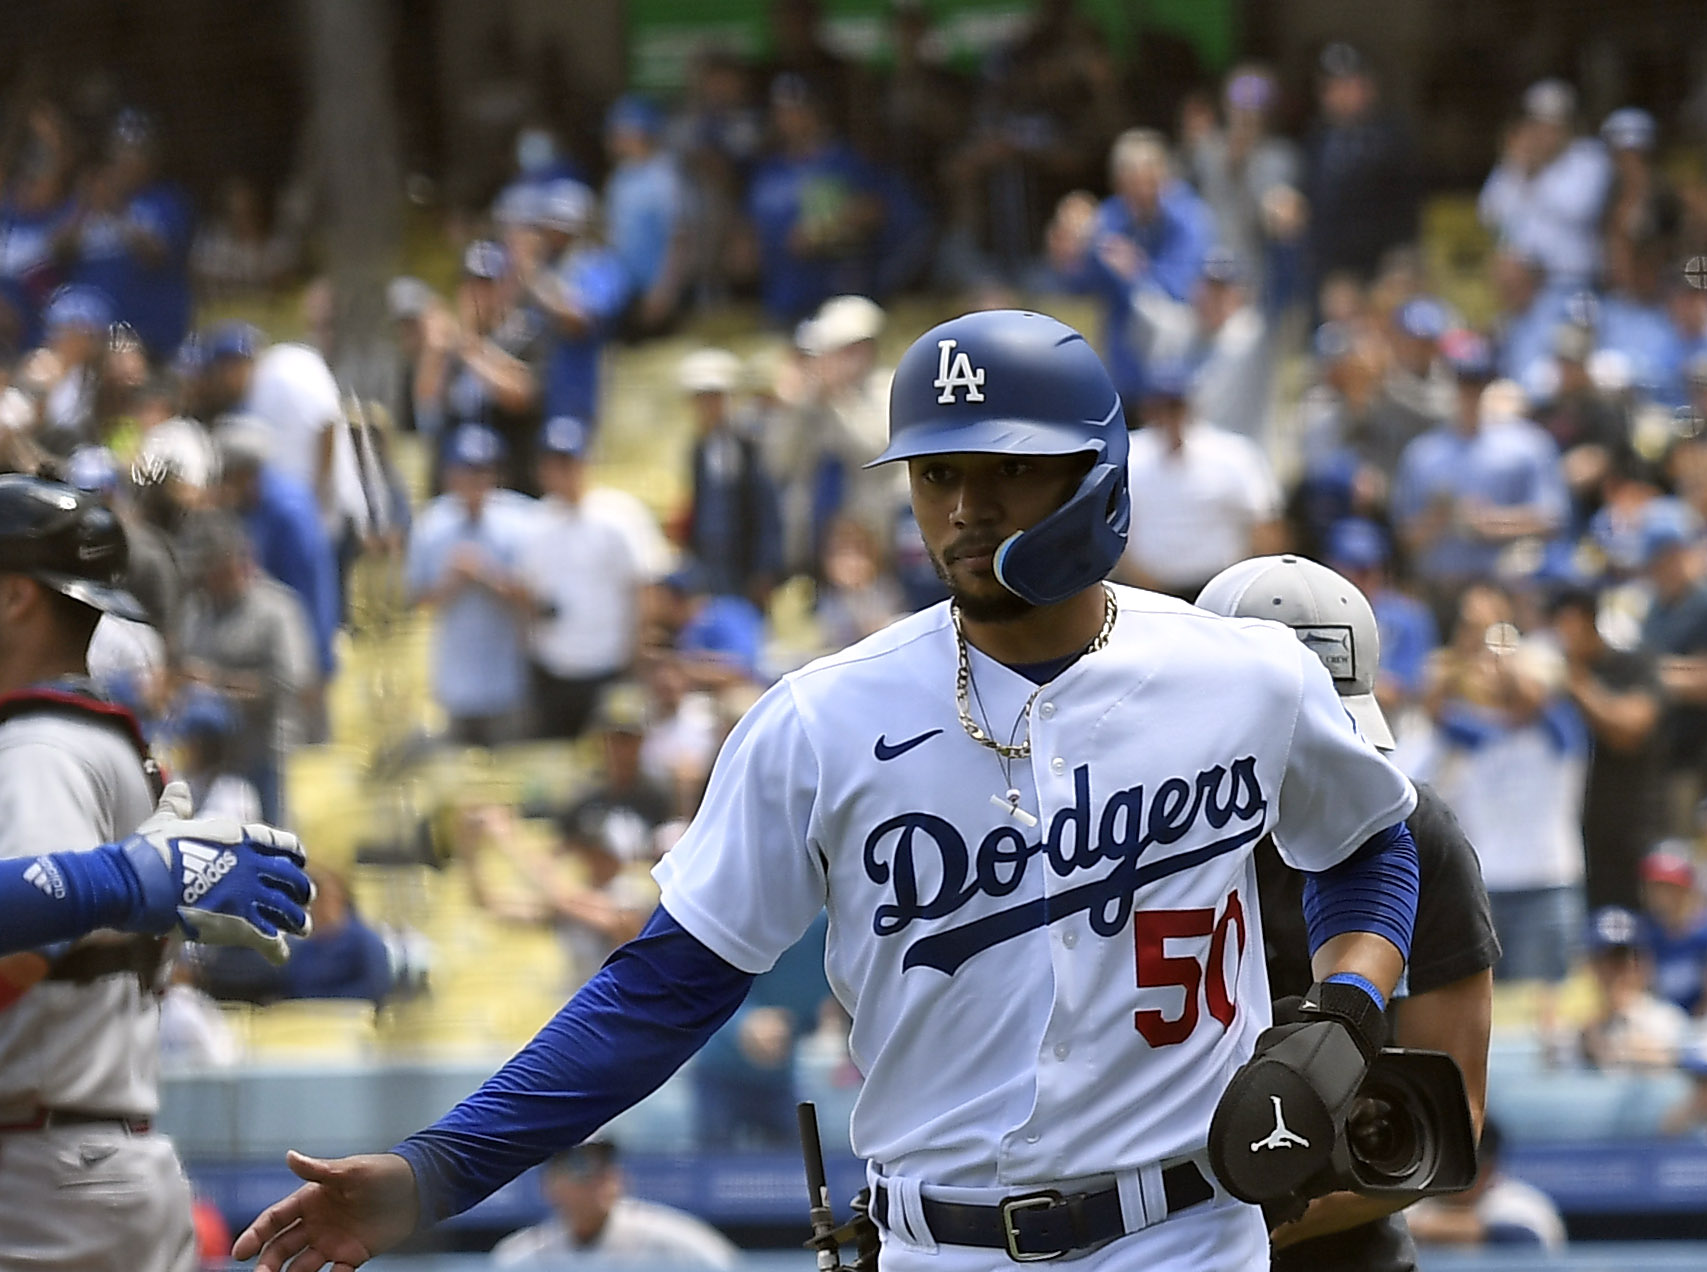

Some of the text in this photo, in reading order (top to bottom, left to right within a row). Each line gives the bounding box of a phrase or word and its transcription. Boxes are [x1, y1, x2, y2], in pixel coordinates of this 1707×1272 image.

[934, 340, 985, 404] LA
[183, 849, 238, 904] adidas
[863, 755, 1267, 938] Dodgers
[1134, 889, 1246, 1049] 50
